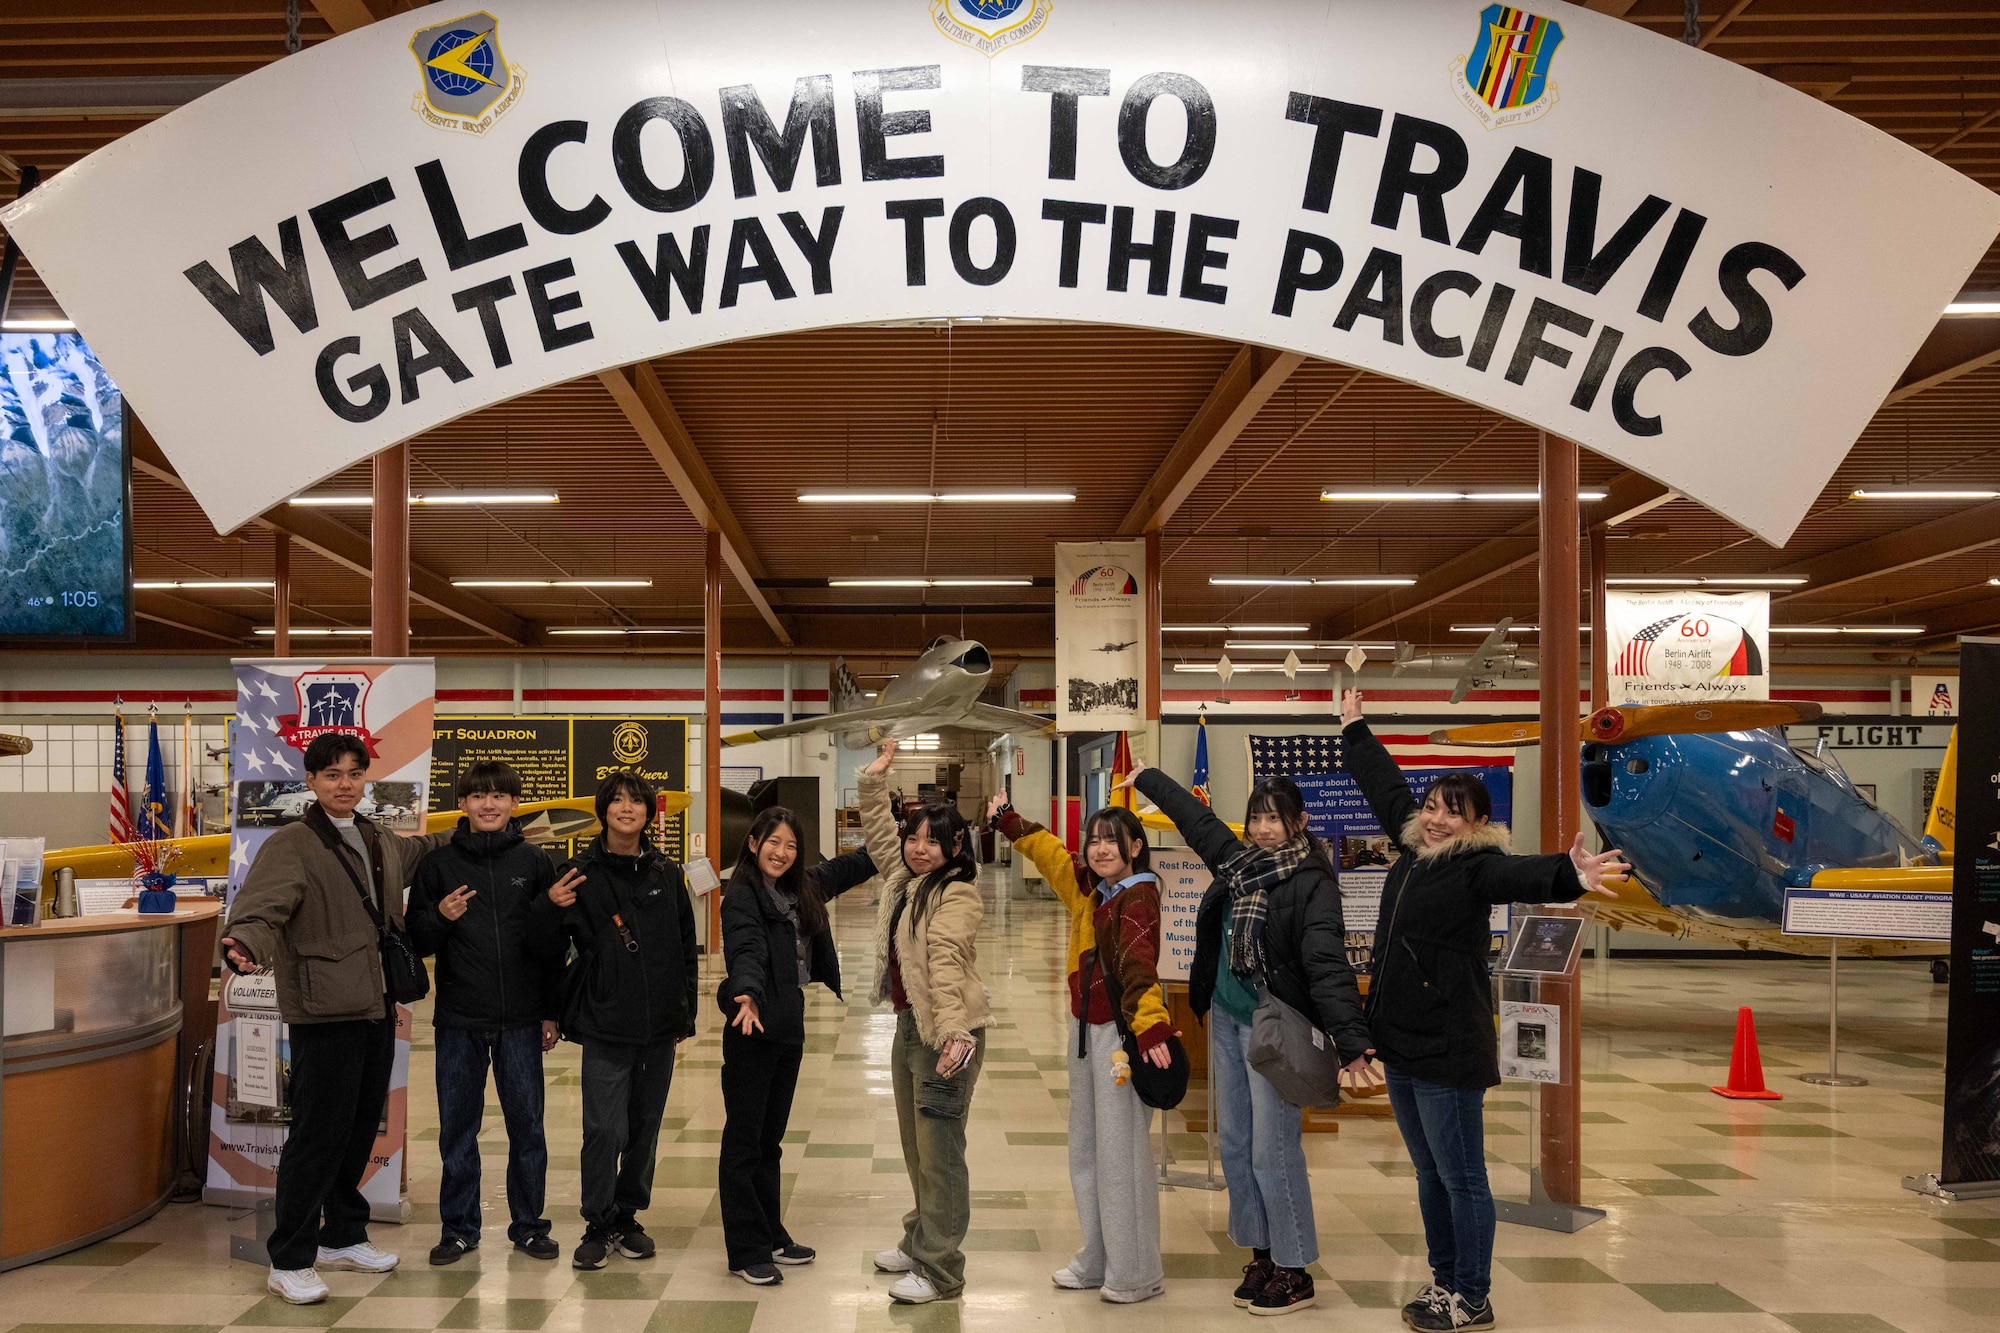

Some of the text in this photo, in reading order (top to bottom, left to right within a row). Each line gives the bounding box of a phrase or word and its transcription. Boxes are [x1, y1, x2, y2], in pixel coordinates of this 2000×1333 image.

[937, 7, 1045, 53] MILITARY AIRLIFT COMMAND
[1462, 91, 1548, 127] MILITARY AIRLIFT WING
[421, 101, 459, 129] TWENTY
[462, 115, 492, 133] SECOND
[183, 65, 1806, 356] WELCOME TO TRAVIS
[315, 197, 1693, 437] GATE WAY TO THE PACIFIC
[1100, 568, 1114, 577] 60
[61, 590, 98, 608] 1:05
[1681, 619, 1709, 637] 60
[1664, 649, 1712, 658] Berlin Airlift
[1665, 660, 1712, 669] 1948 2008
[1625, 682, 1746, 693] Friends Always
[297, 728, 358, 740] TRAVIS AFB
[1818, 727, 1922, 746] FLIGHT
[1325, 778, 1349, 787] about
[1319, 790, 1337, 798] Come
[1326, 800, 1337, 808] Air
[1338, 798, 1362, 806] Force
[1306, 813, 1332, 821] There's
[1160, 861, 1180, 870] Rest
[1168, 890, 1206, 898] Located
[1174, 919, 1182, 927] of
[1166, 932, 1197, 942] Museu
[1172, 948, 1181, 956] to
[233, 988, 276, 998] VOLUNTEER
